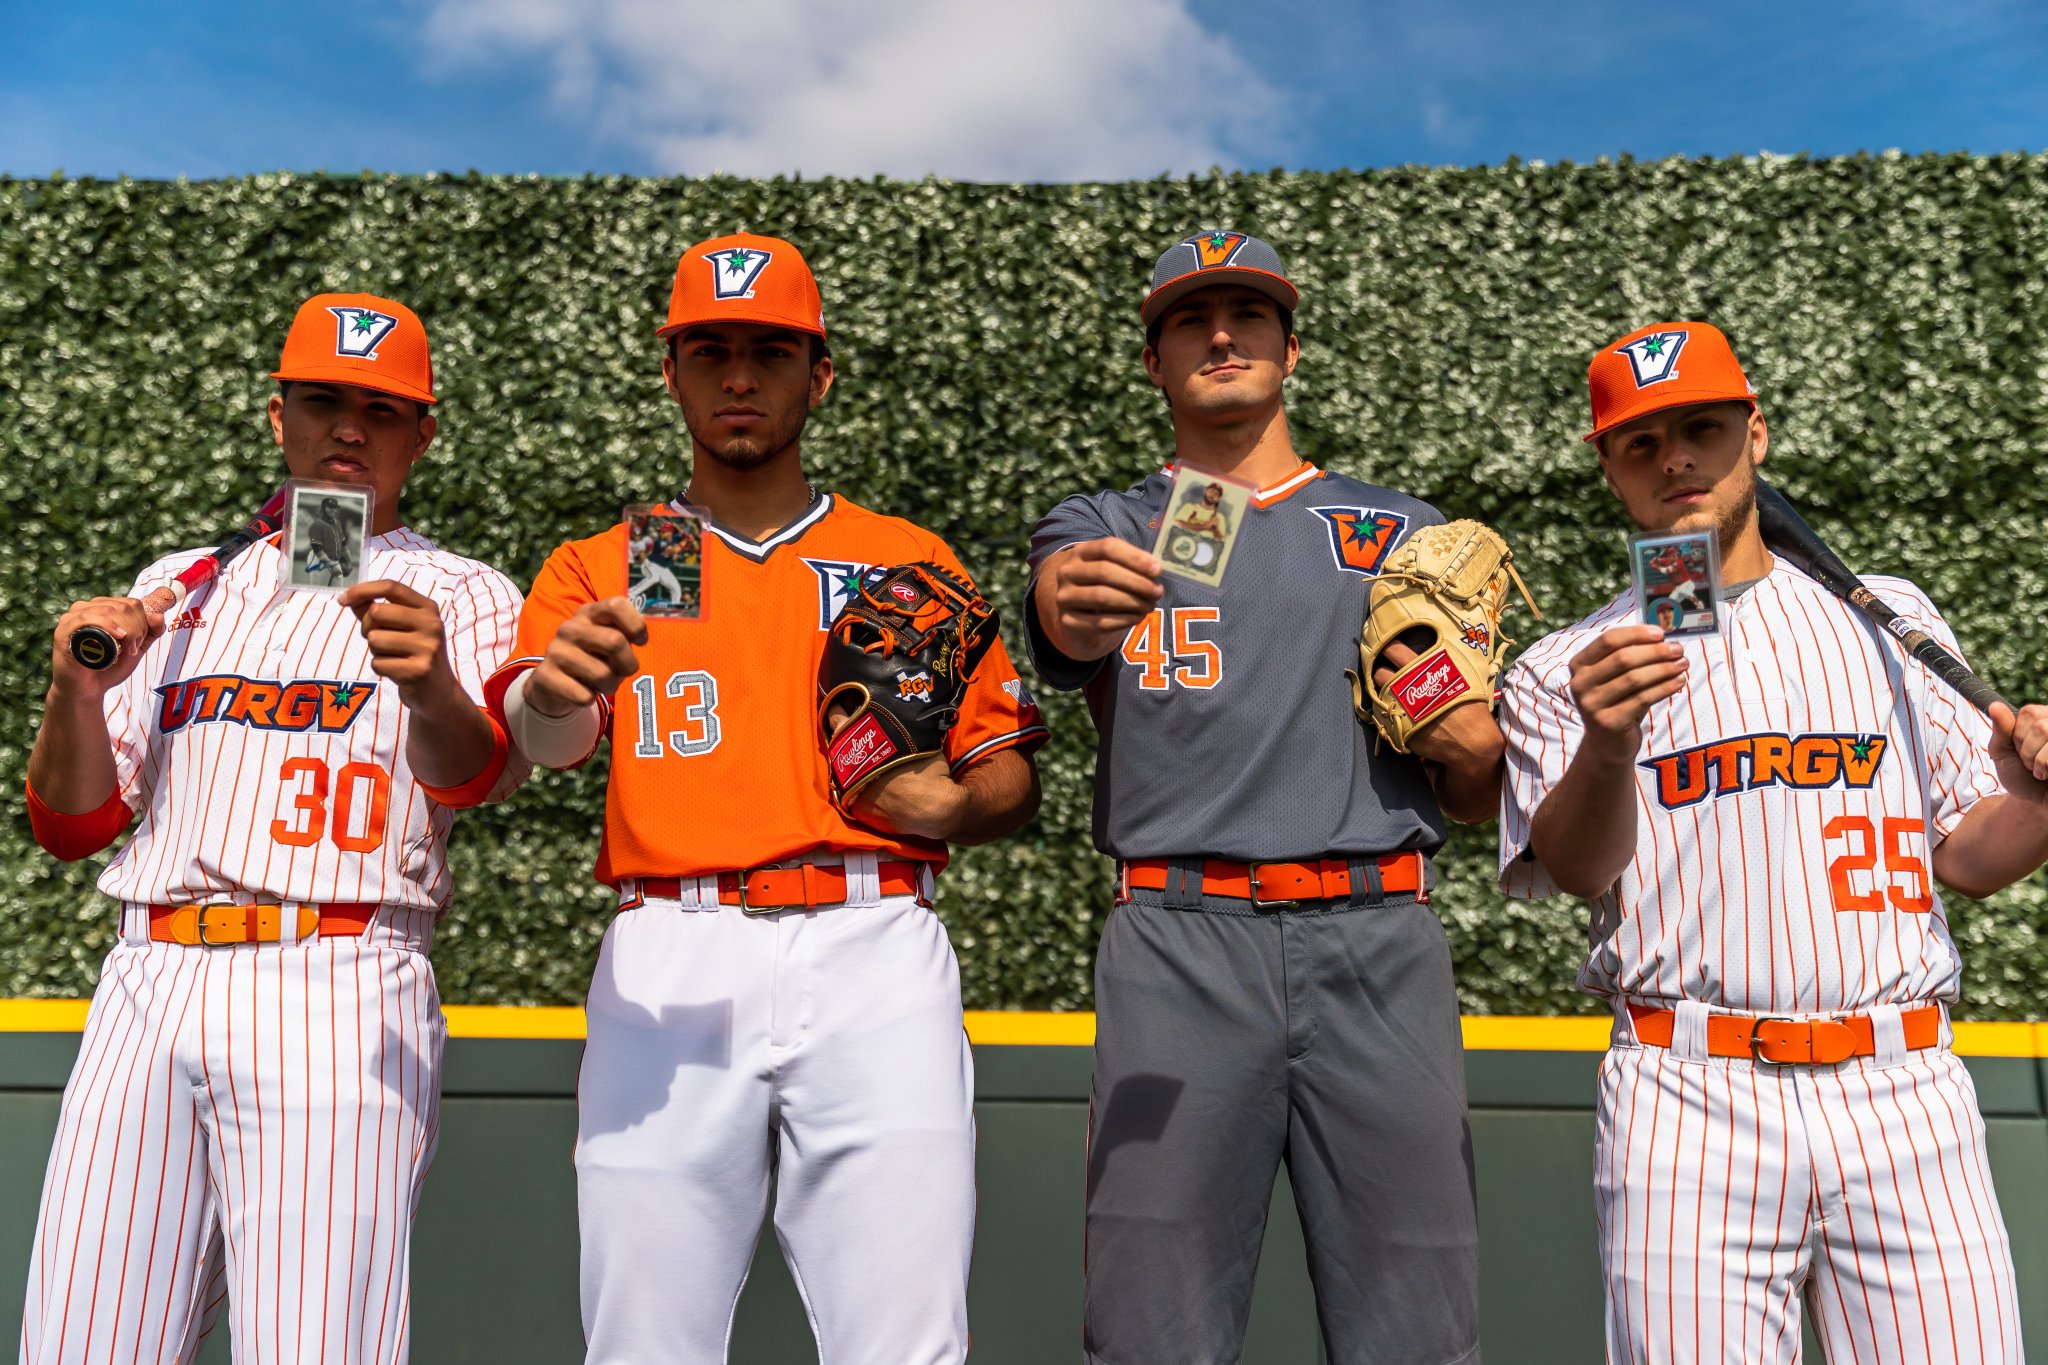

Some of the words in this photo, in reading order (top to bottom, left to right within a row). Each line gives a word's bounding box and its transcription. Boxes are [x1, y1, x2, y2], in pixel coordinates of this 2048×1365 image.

[168, 619, 206, 632] adidas
[1120, 607, 1222, 690] 45
[152, 674, 380, 736] UTRGV
[632, 670, 721, 757] 13
[899, 677, 934, 696] RGV
[1406, 664, 1451, 705] Rawlings
[837, 729, 877, 772] Rawlings
[1634, 731, 1888, 813] UTRGV
[270, 757, 390, 854] 30
[1824, 816, 1933, 913] 25
